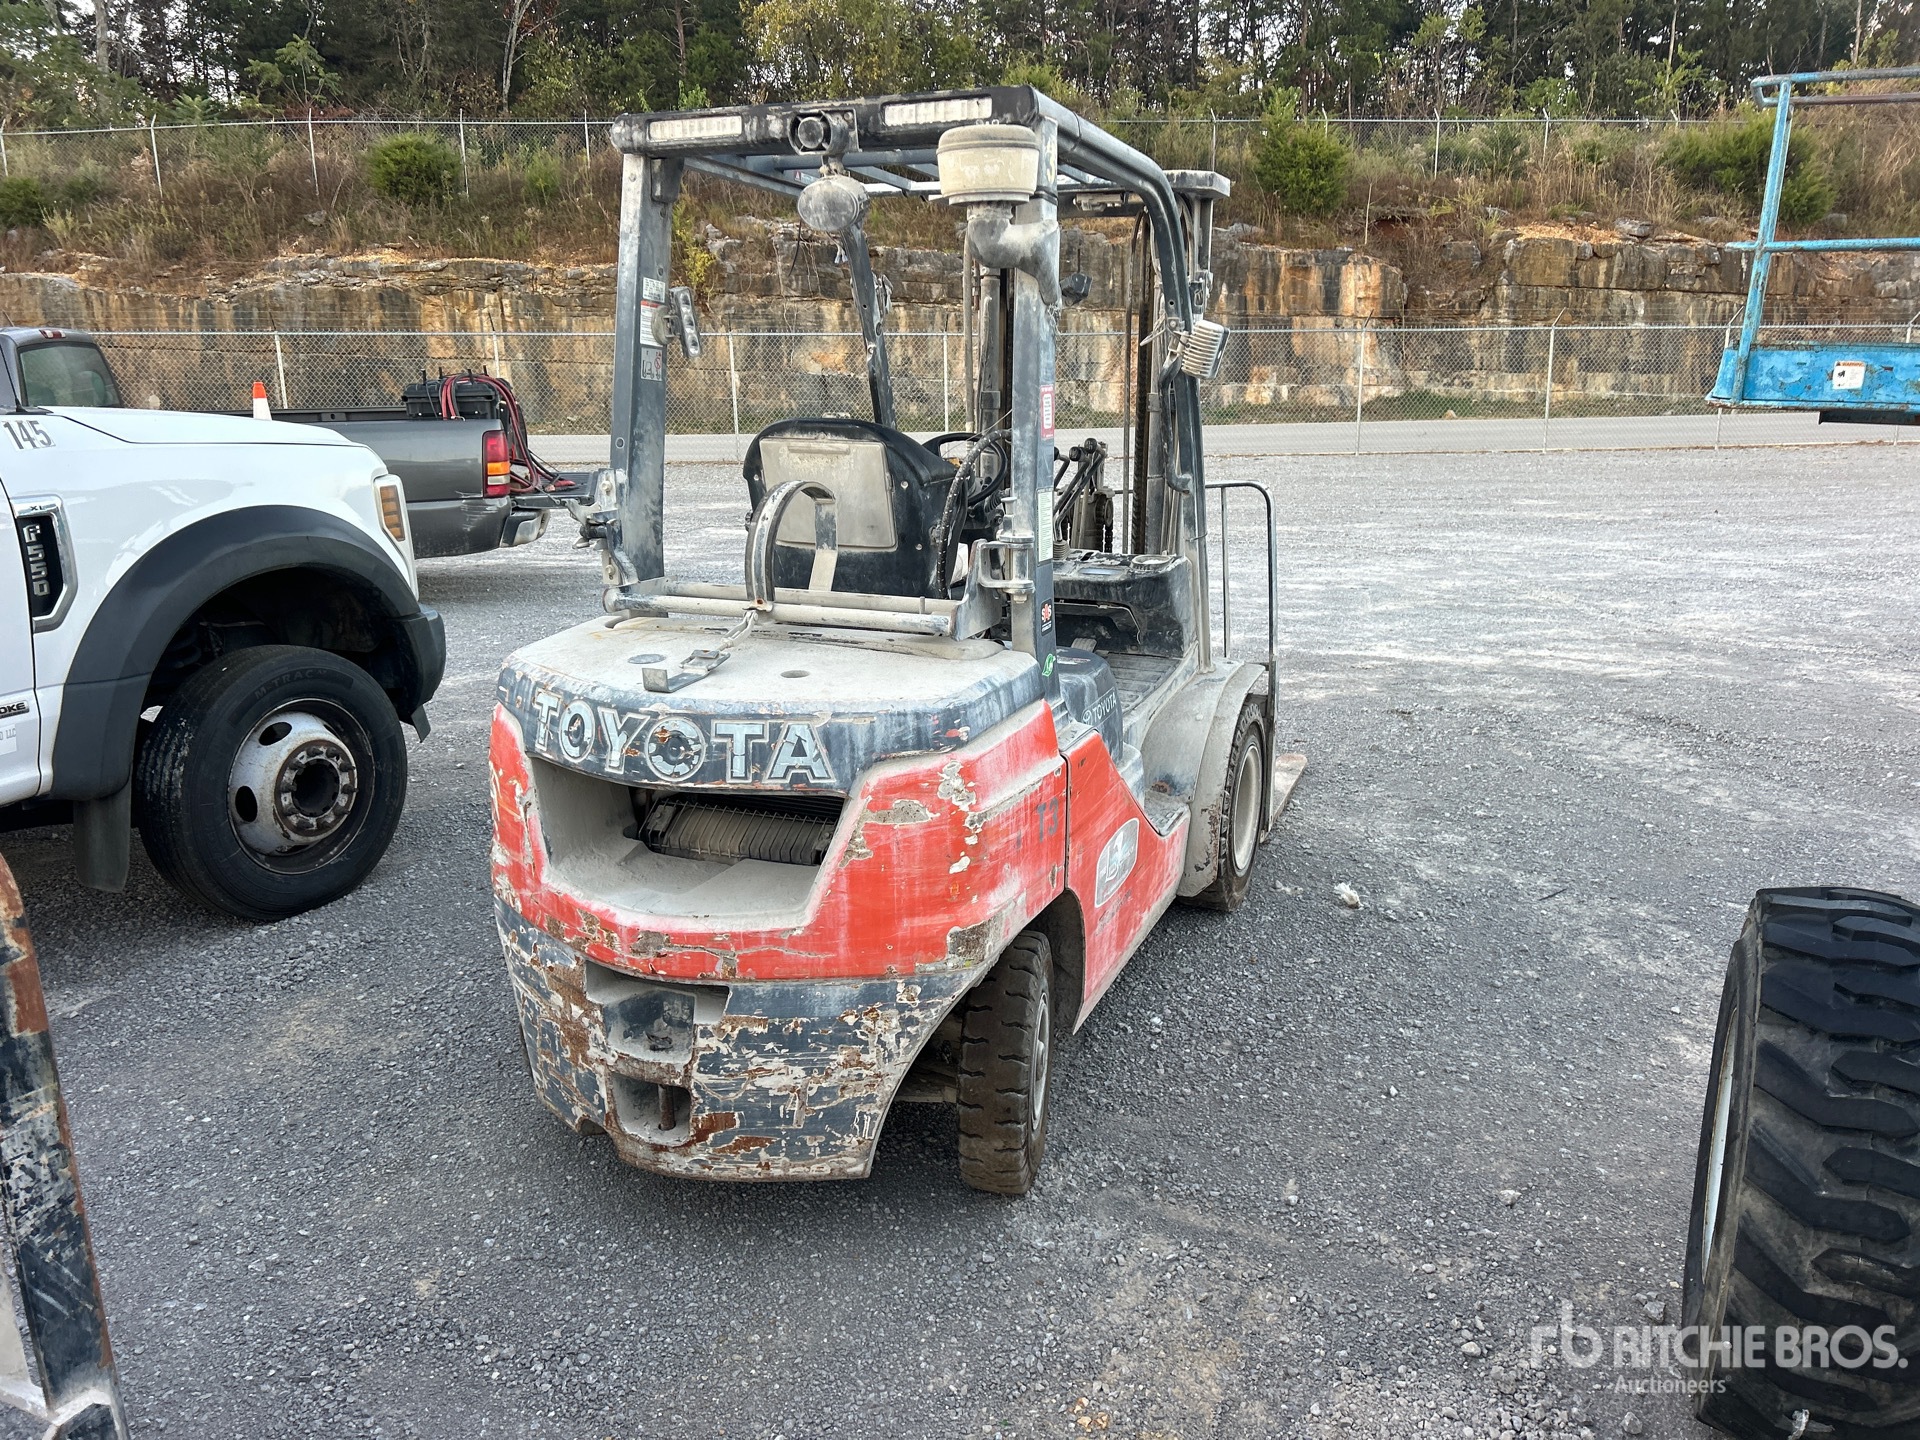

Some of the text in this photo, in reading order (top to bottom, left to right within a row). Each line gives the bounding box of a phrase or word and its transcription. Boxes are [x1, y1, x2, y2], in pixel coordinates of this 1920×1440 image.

[3, 420, 52, 449] 145
[1092, 691, 1117, 723] TOYOTA
[532, 687, 836, 784] TOYOTA
